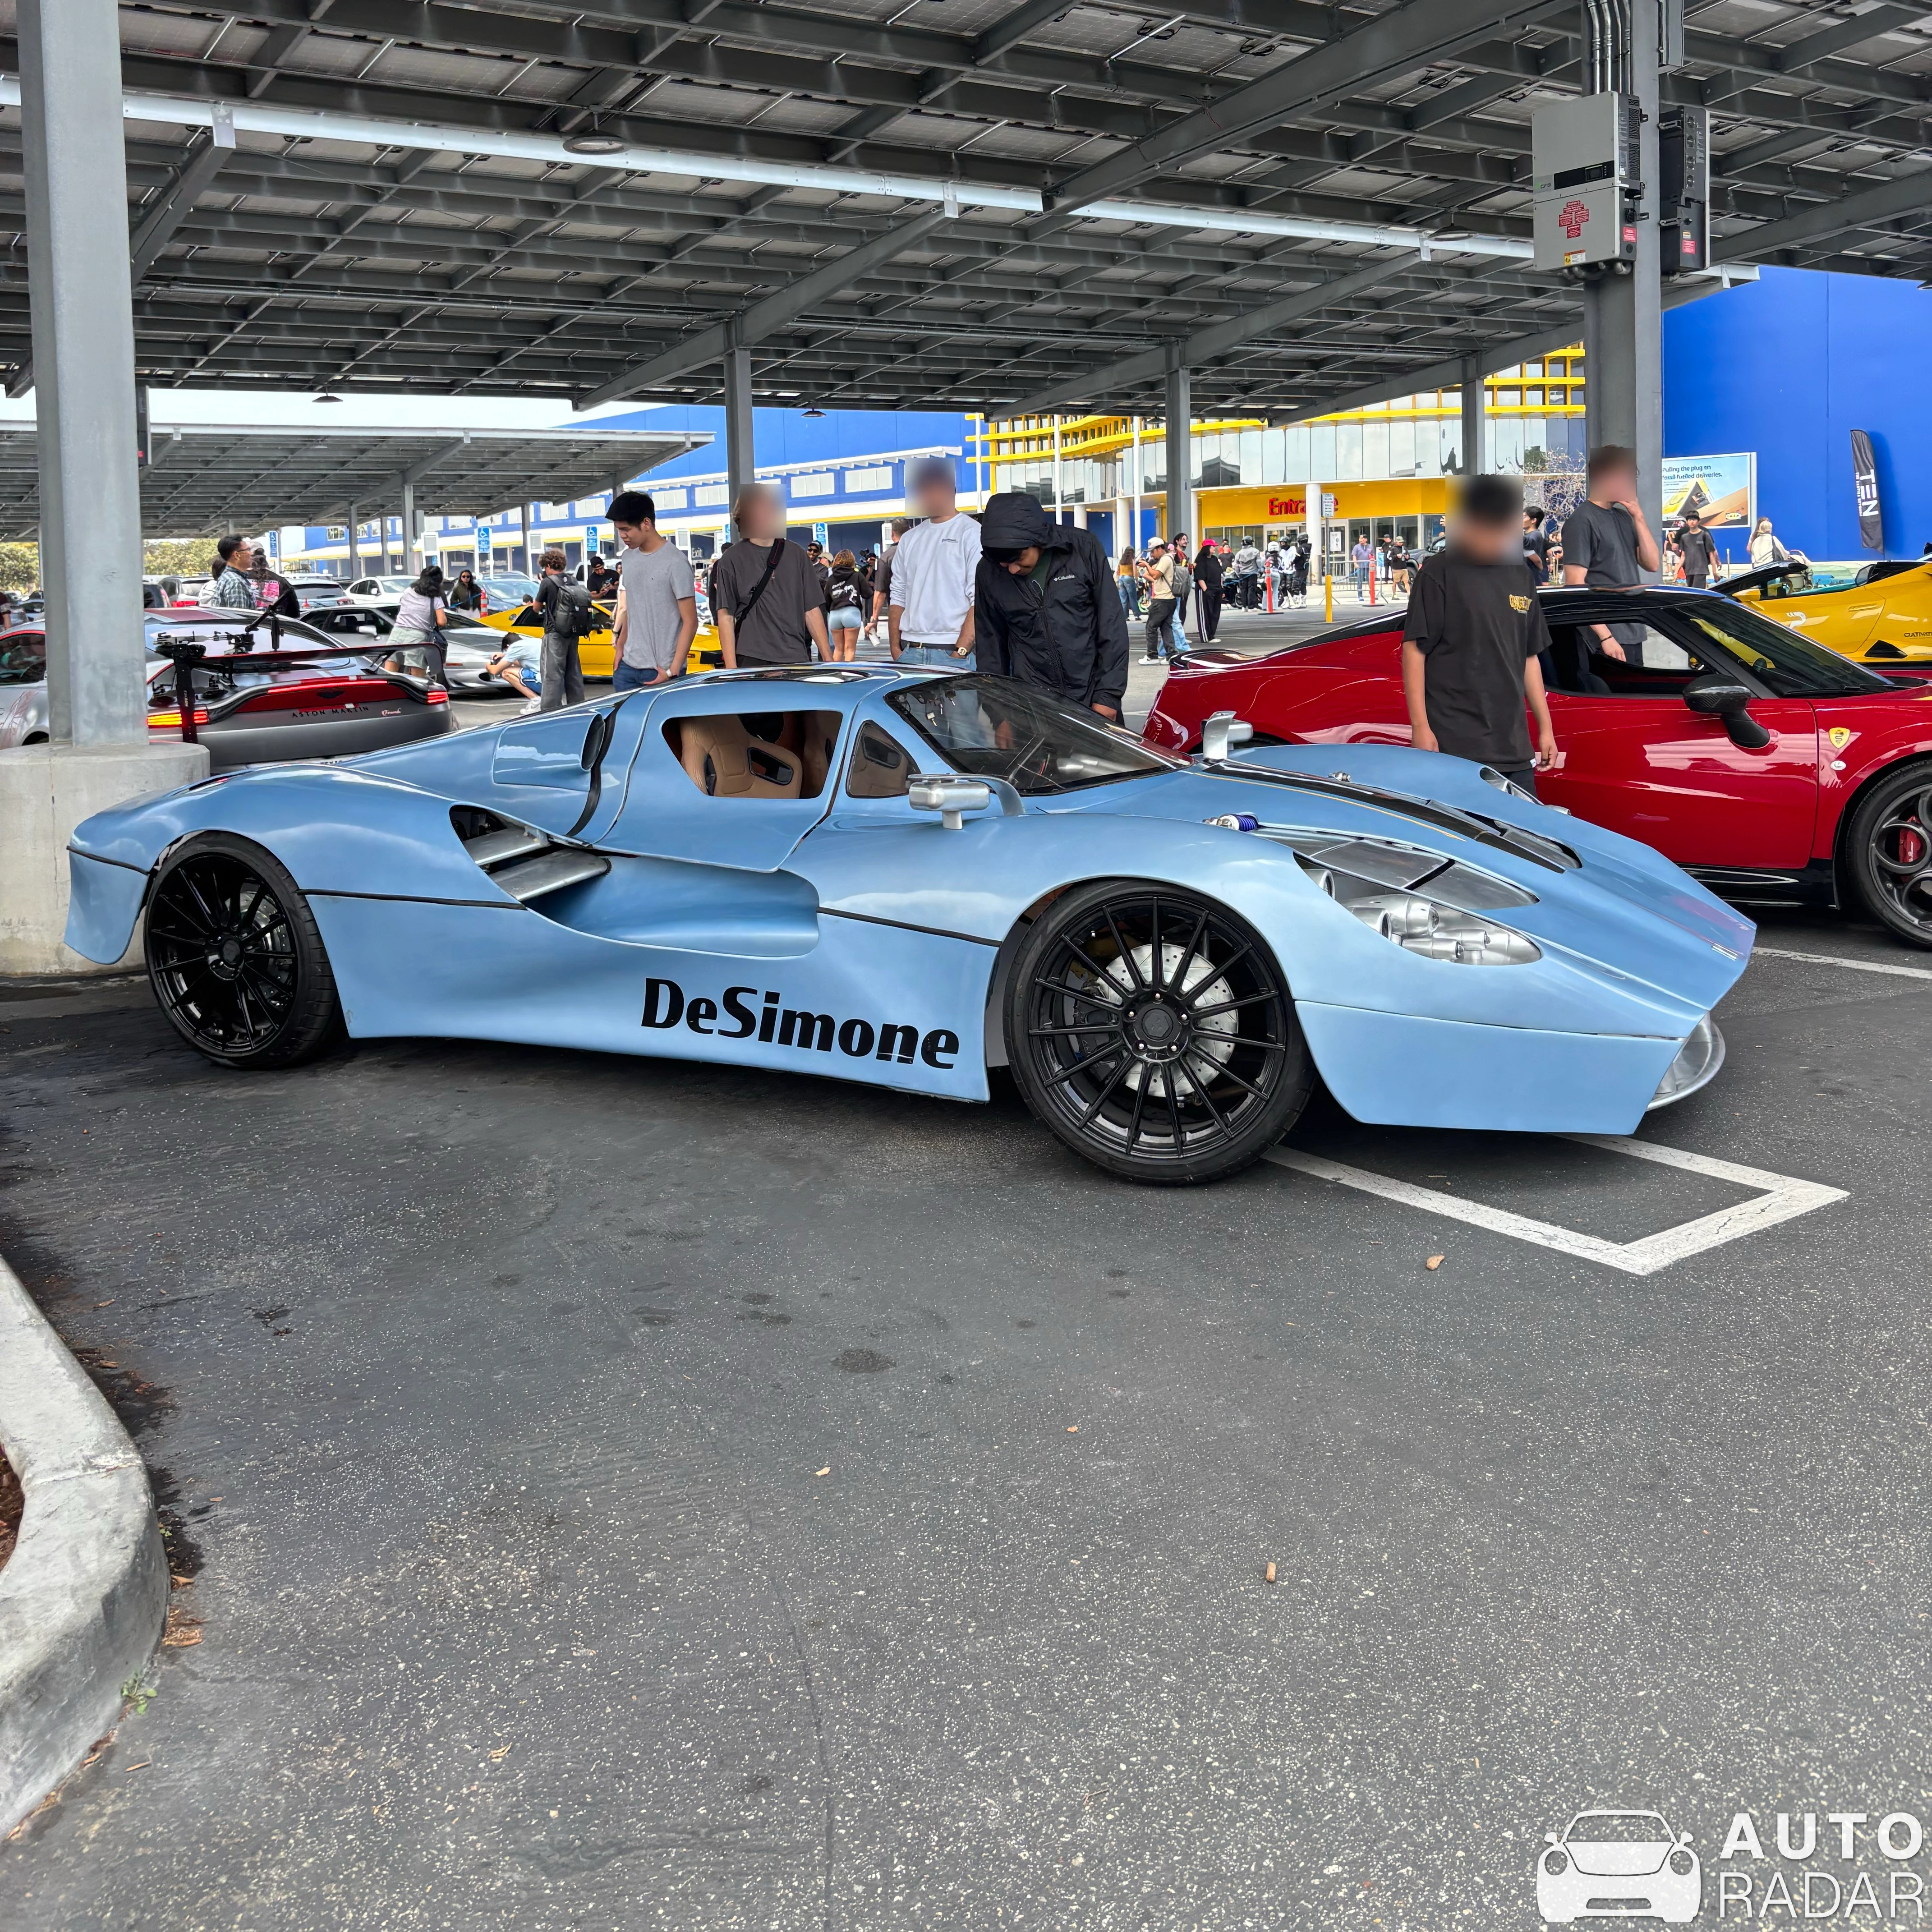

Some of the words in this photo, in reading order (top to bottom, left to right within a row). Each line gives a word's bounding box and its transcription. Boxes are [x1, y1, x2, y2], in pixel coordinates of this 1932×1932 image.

[1860, 469, 1879, 516] TEN
[292, 709, 326, 718] ASTON
[641, 977, 960, 1069] DeSimone
